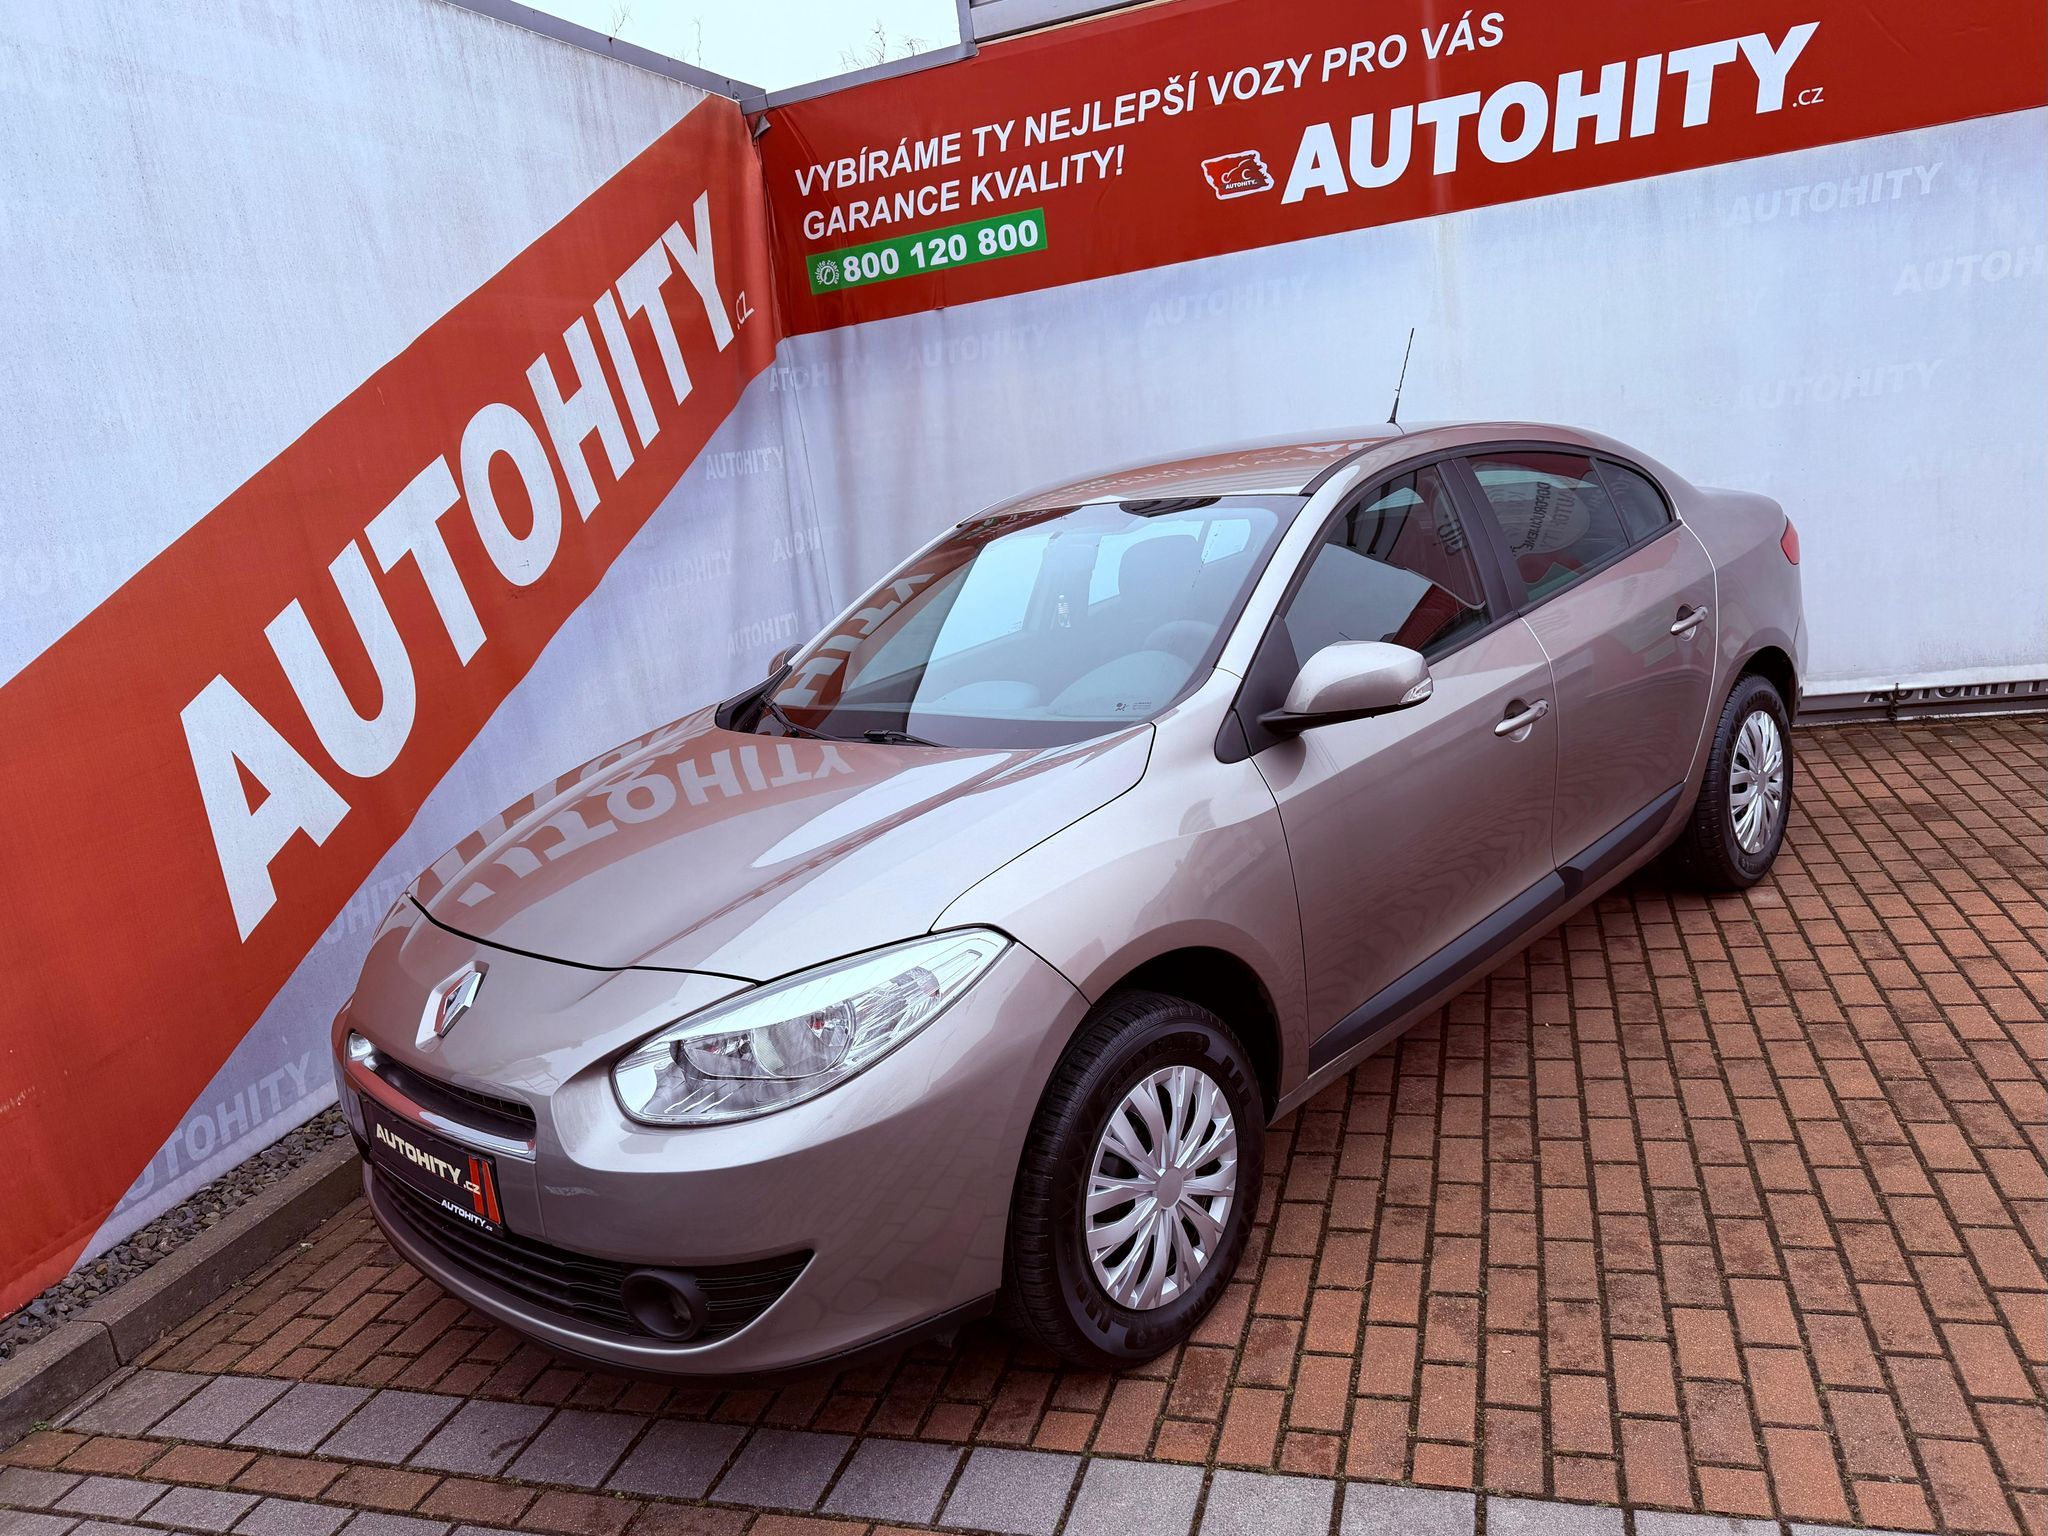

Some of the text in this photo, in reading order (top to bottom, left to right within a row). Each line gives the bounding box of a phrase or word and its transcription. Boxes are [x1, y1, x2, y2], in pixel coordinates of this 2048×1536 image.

[795, 9, 1505, 197] VYBÍRÁME TY NEJLEPŠÍ VOZY PRO VÁS
[803, 144, 1125, 240] GARANCE KVALITY!
[1724, 163, 1943, 228] AUTOHITY
[842, 219, 1039, 282] 800 120 800
